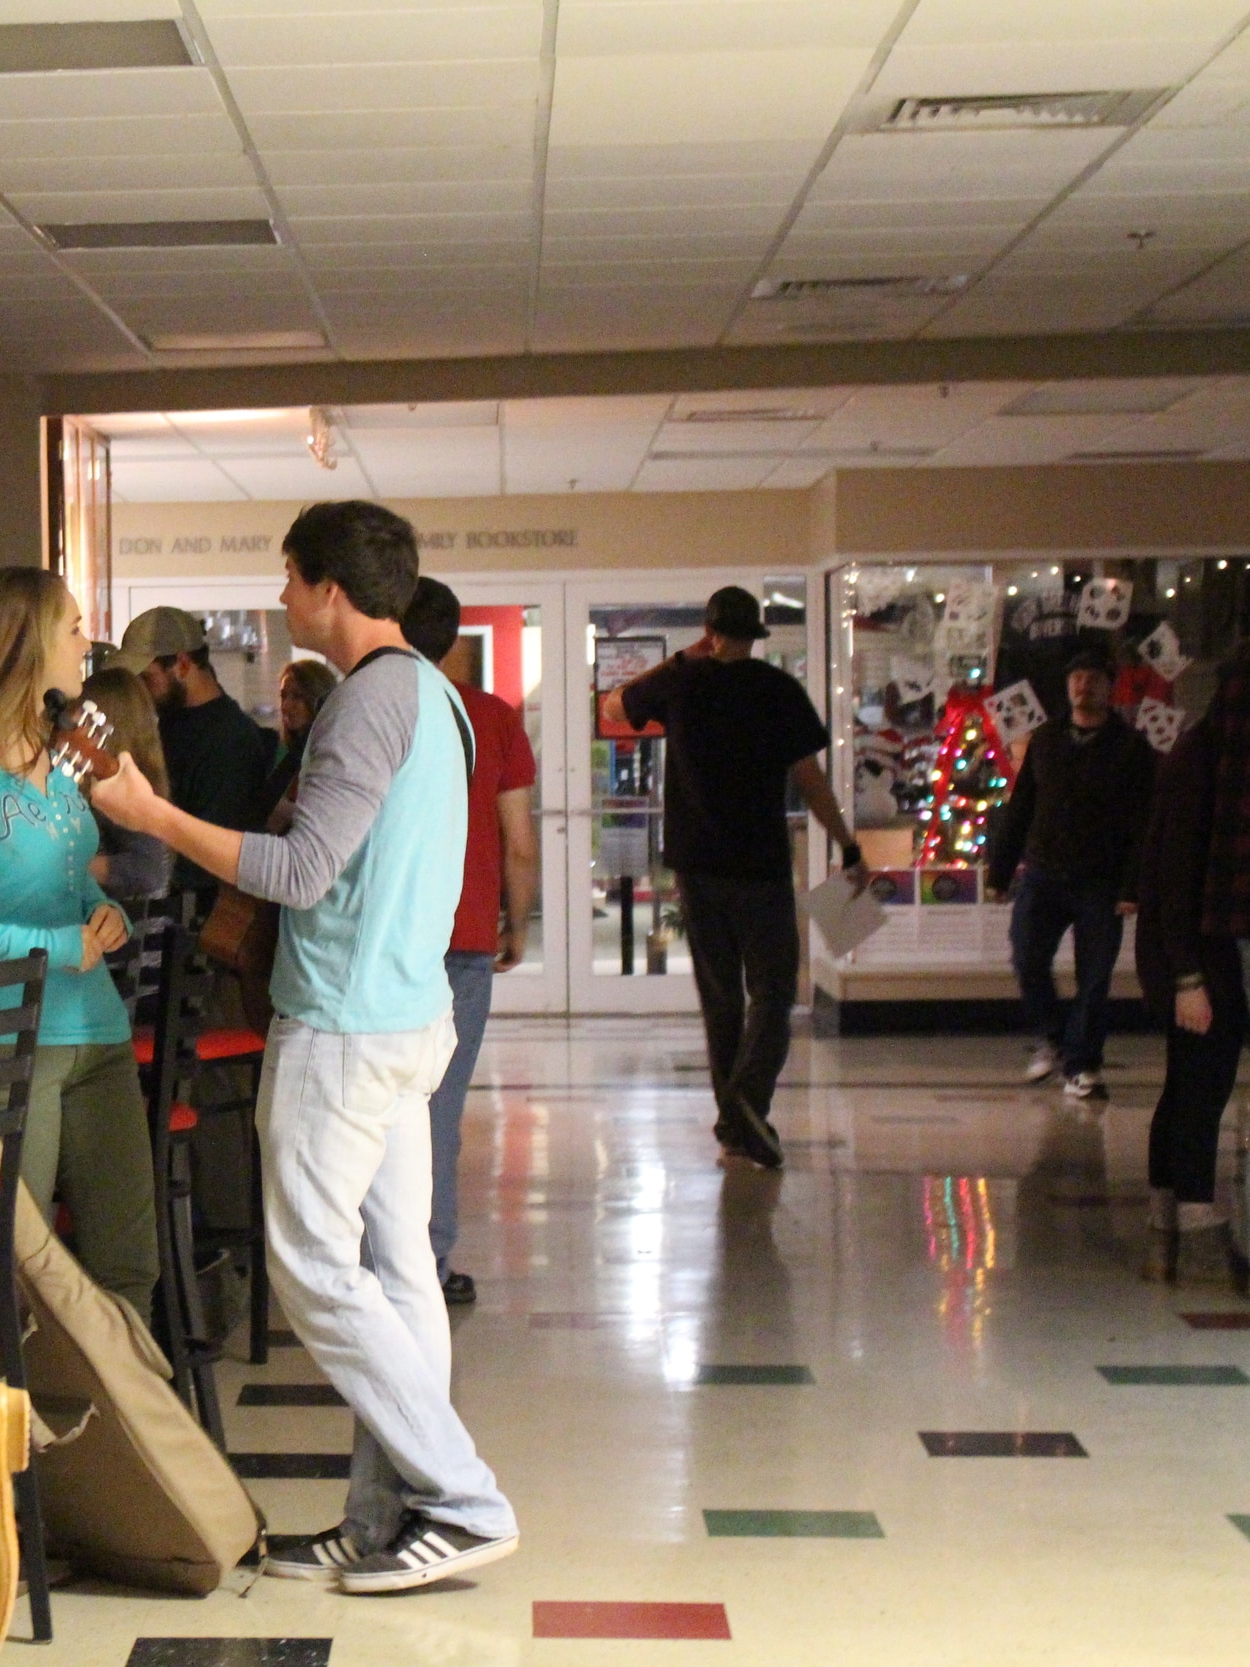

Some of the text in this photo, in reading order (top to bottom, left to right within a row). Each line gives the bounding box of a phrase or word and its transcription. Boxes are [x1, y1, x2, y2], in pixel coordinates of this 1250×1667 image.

[119, 537, 162, 554] DON
[171, 536, 211, 553] AND
[221, 535, 273, 553] MARY
[465, 528, 578, 549] BOOKSTORE
